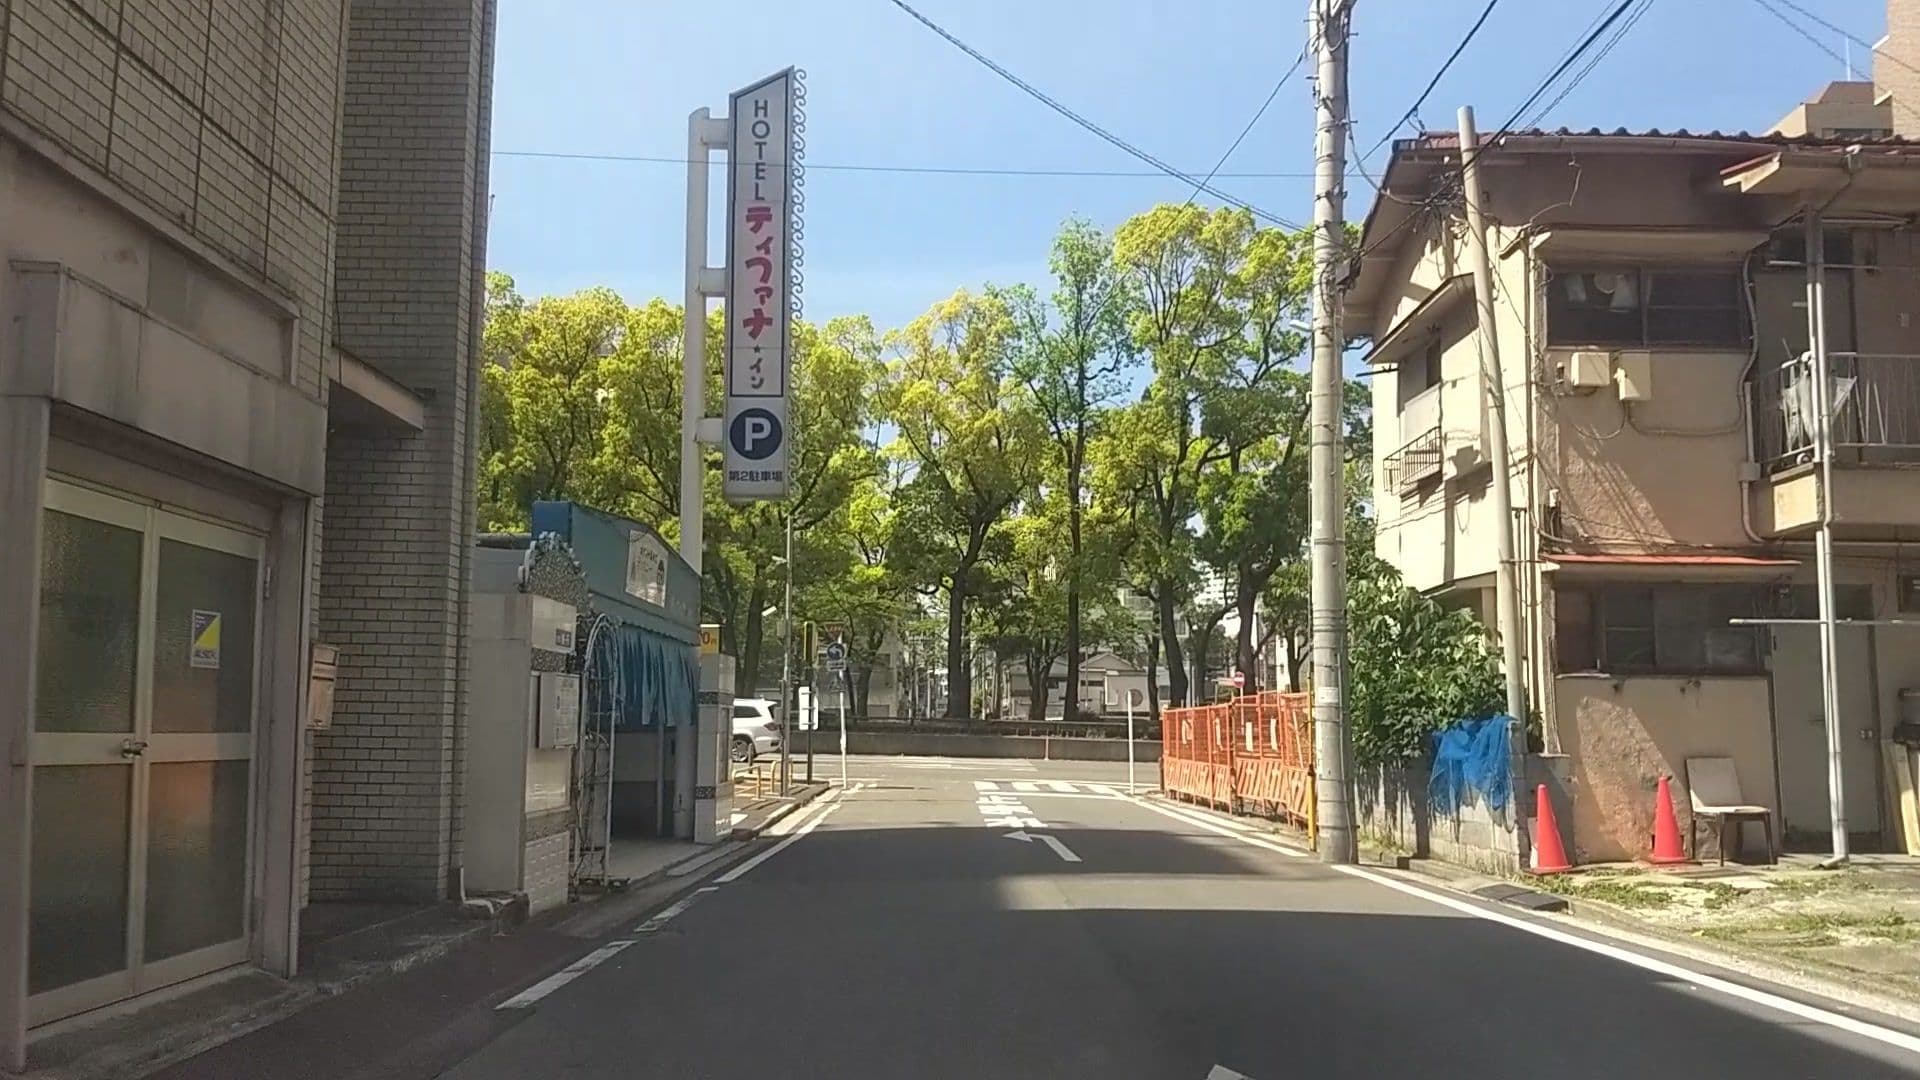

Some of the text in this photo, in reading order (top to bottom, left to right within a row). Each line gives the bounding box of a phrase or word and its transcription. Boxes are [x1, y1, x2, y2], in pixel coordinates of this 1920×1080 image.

[751, 99, 771, 201] HOTEL
[743, 416, 772, 451] P
[729, 470, 783, 482] 第2駐車場
